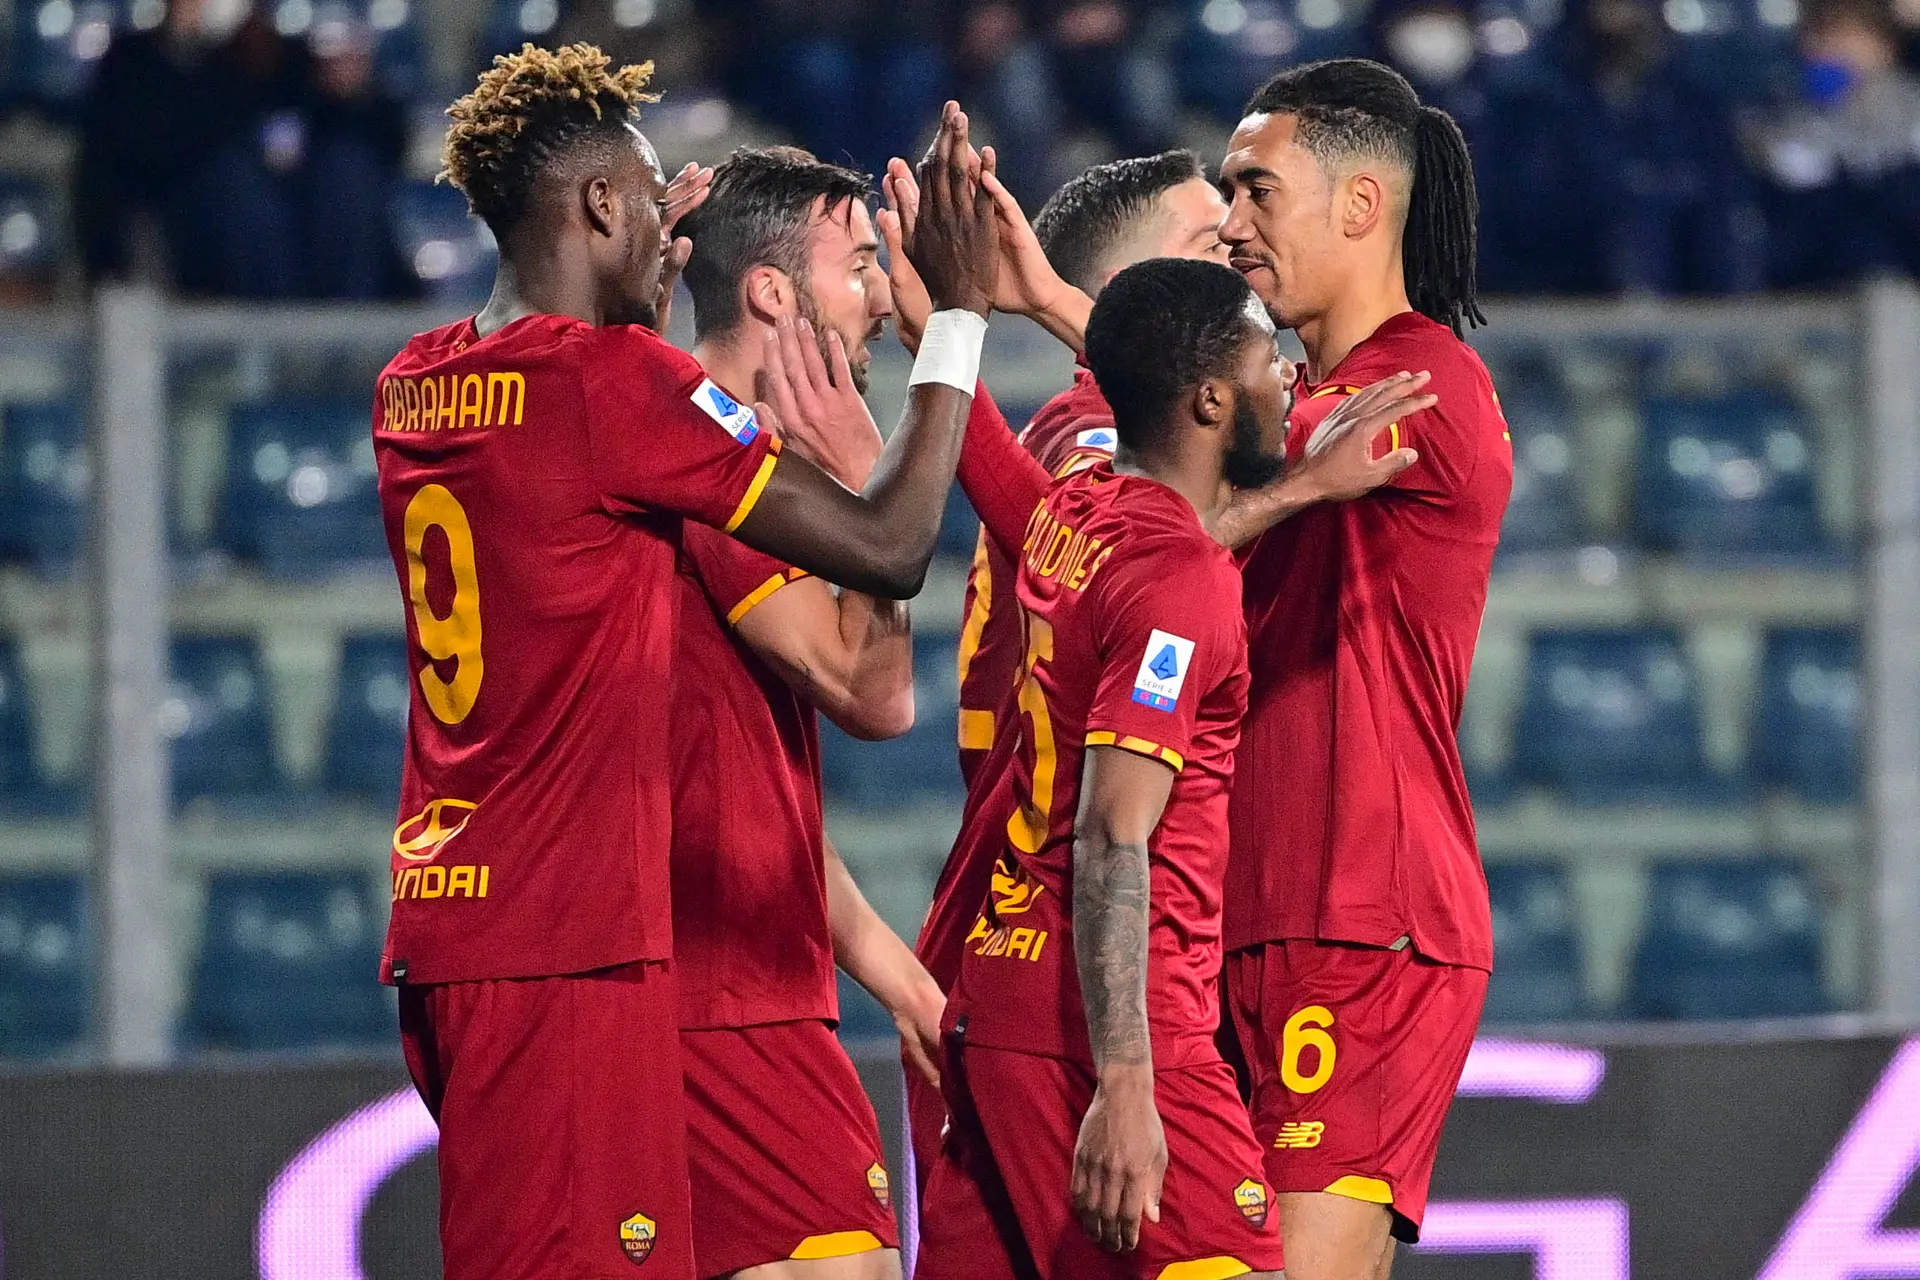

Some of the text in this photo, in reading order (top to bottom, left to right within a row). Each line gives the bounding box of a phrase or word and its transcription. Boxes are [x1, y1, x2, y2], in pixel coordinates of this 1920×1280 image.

[382, 371, 526, 432] ABRAHAM
[404, 483, 484, 725] 9
[1142, 679, 1165, 692] SERIE
[1281, 1005, 1337, 1095] 6
[625, 1241, 651, 1251] ROMA
